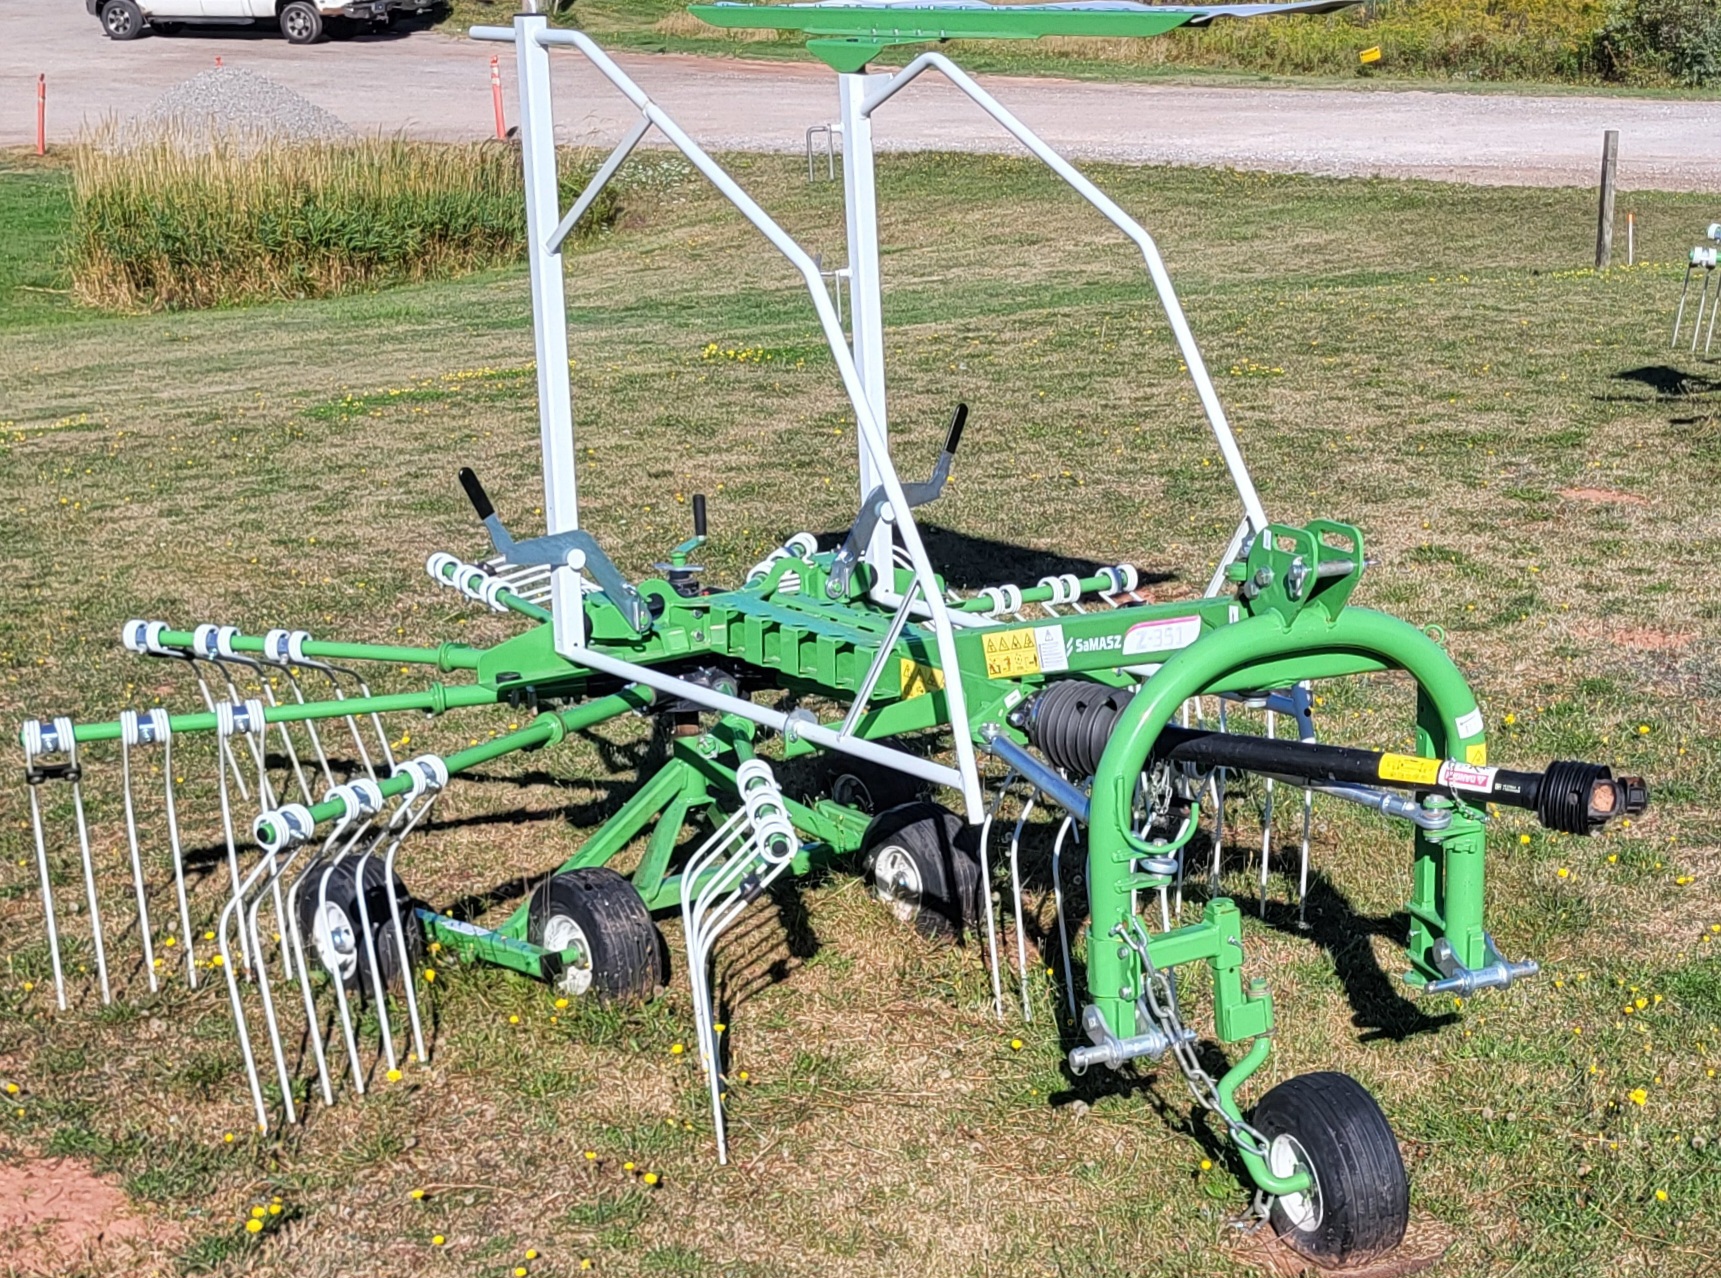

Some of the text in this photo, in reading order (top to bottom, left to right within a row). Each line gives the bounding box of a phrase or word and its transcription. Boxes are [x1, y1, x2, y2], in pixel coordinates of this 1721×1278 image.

[1075, 635, 1122, 653] SaMASZ
[1136, 626, 1184, 650] Z-351
[1446, 771, 1477, 785] DANG
